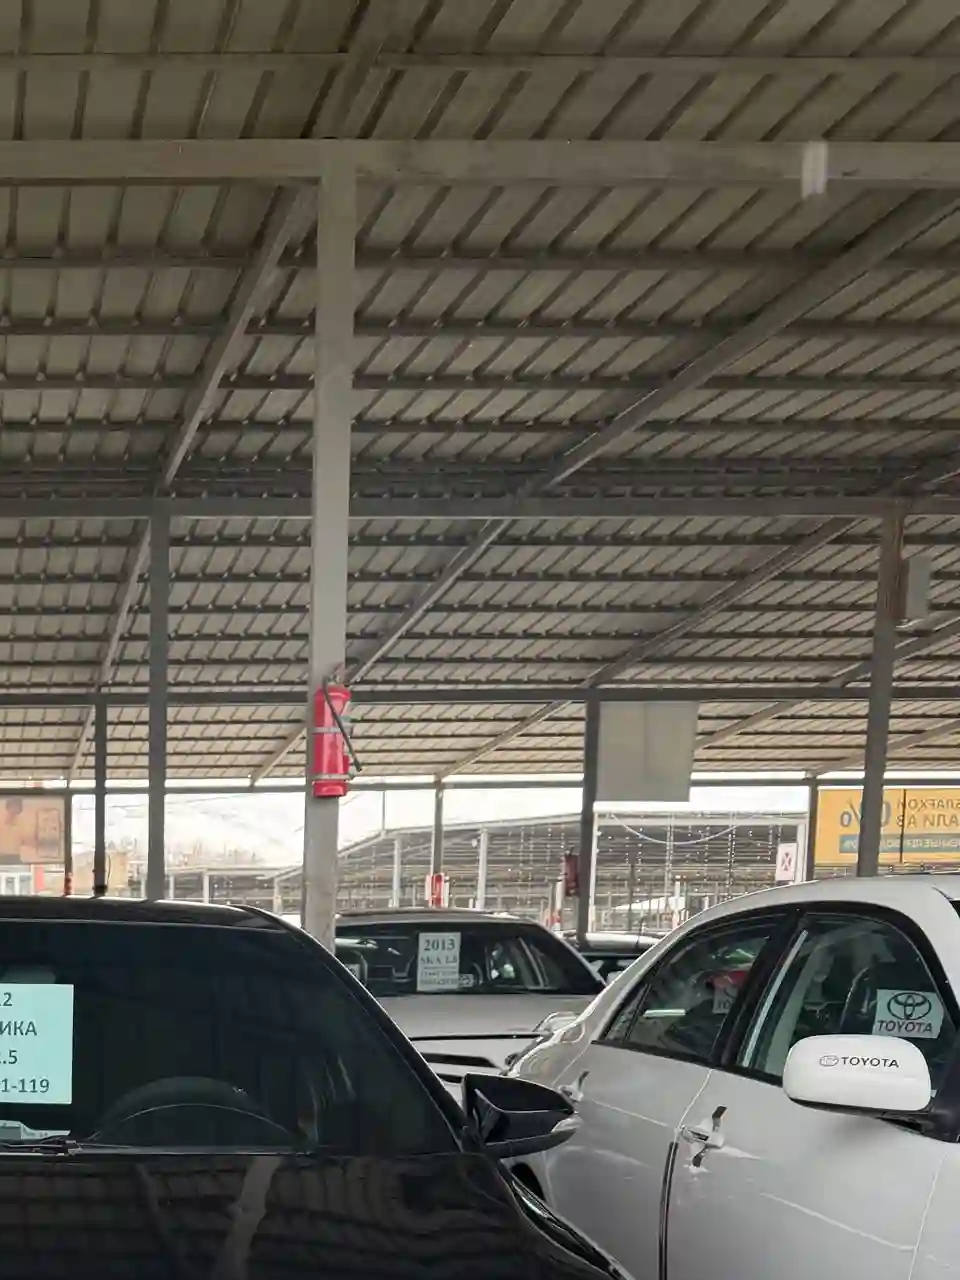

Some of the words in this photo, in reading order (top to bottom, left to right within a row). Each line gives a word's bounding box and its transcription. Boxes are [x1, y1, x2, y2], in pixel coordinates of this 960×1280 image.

[424, 939, 455, 951] 2013
[877, 1019, 933, 1034] TOYOTA
[841, 1056, 900, 1068] TOYOTA
